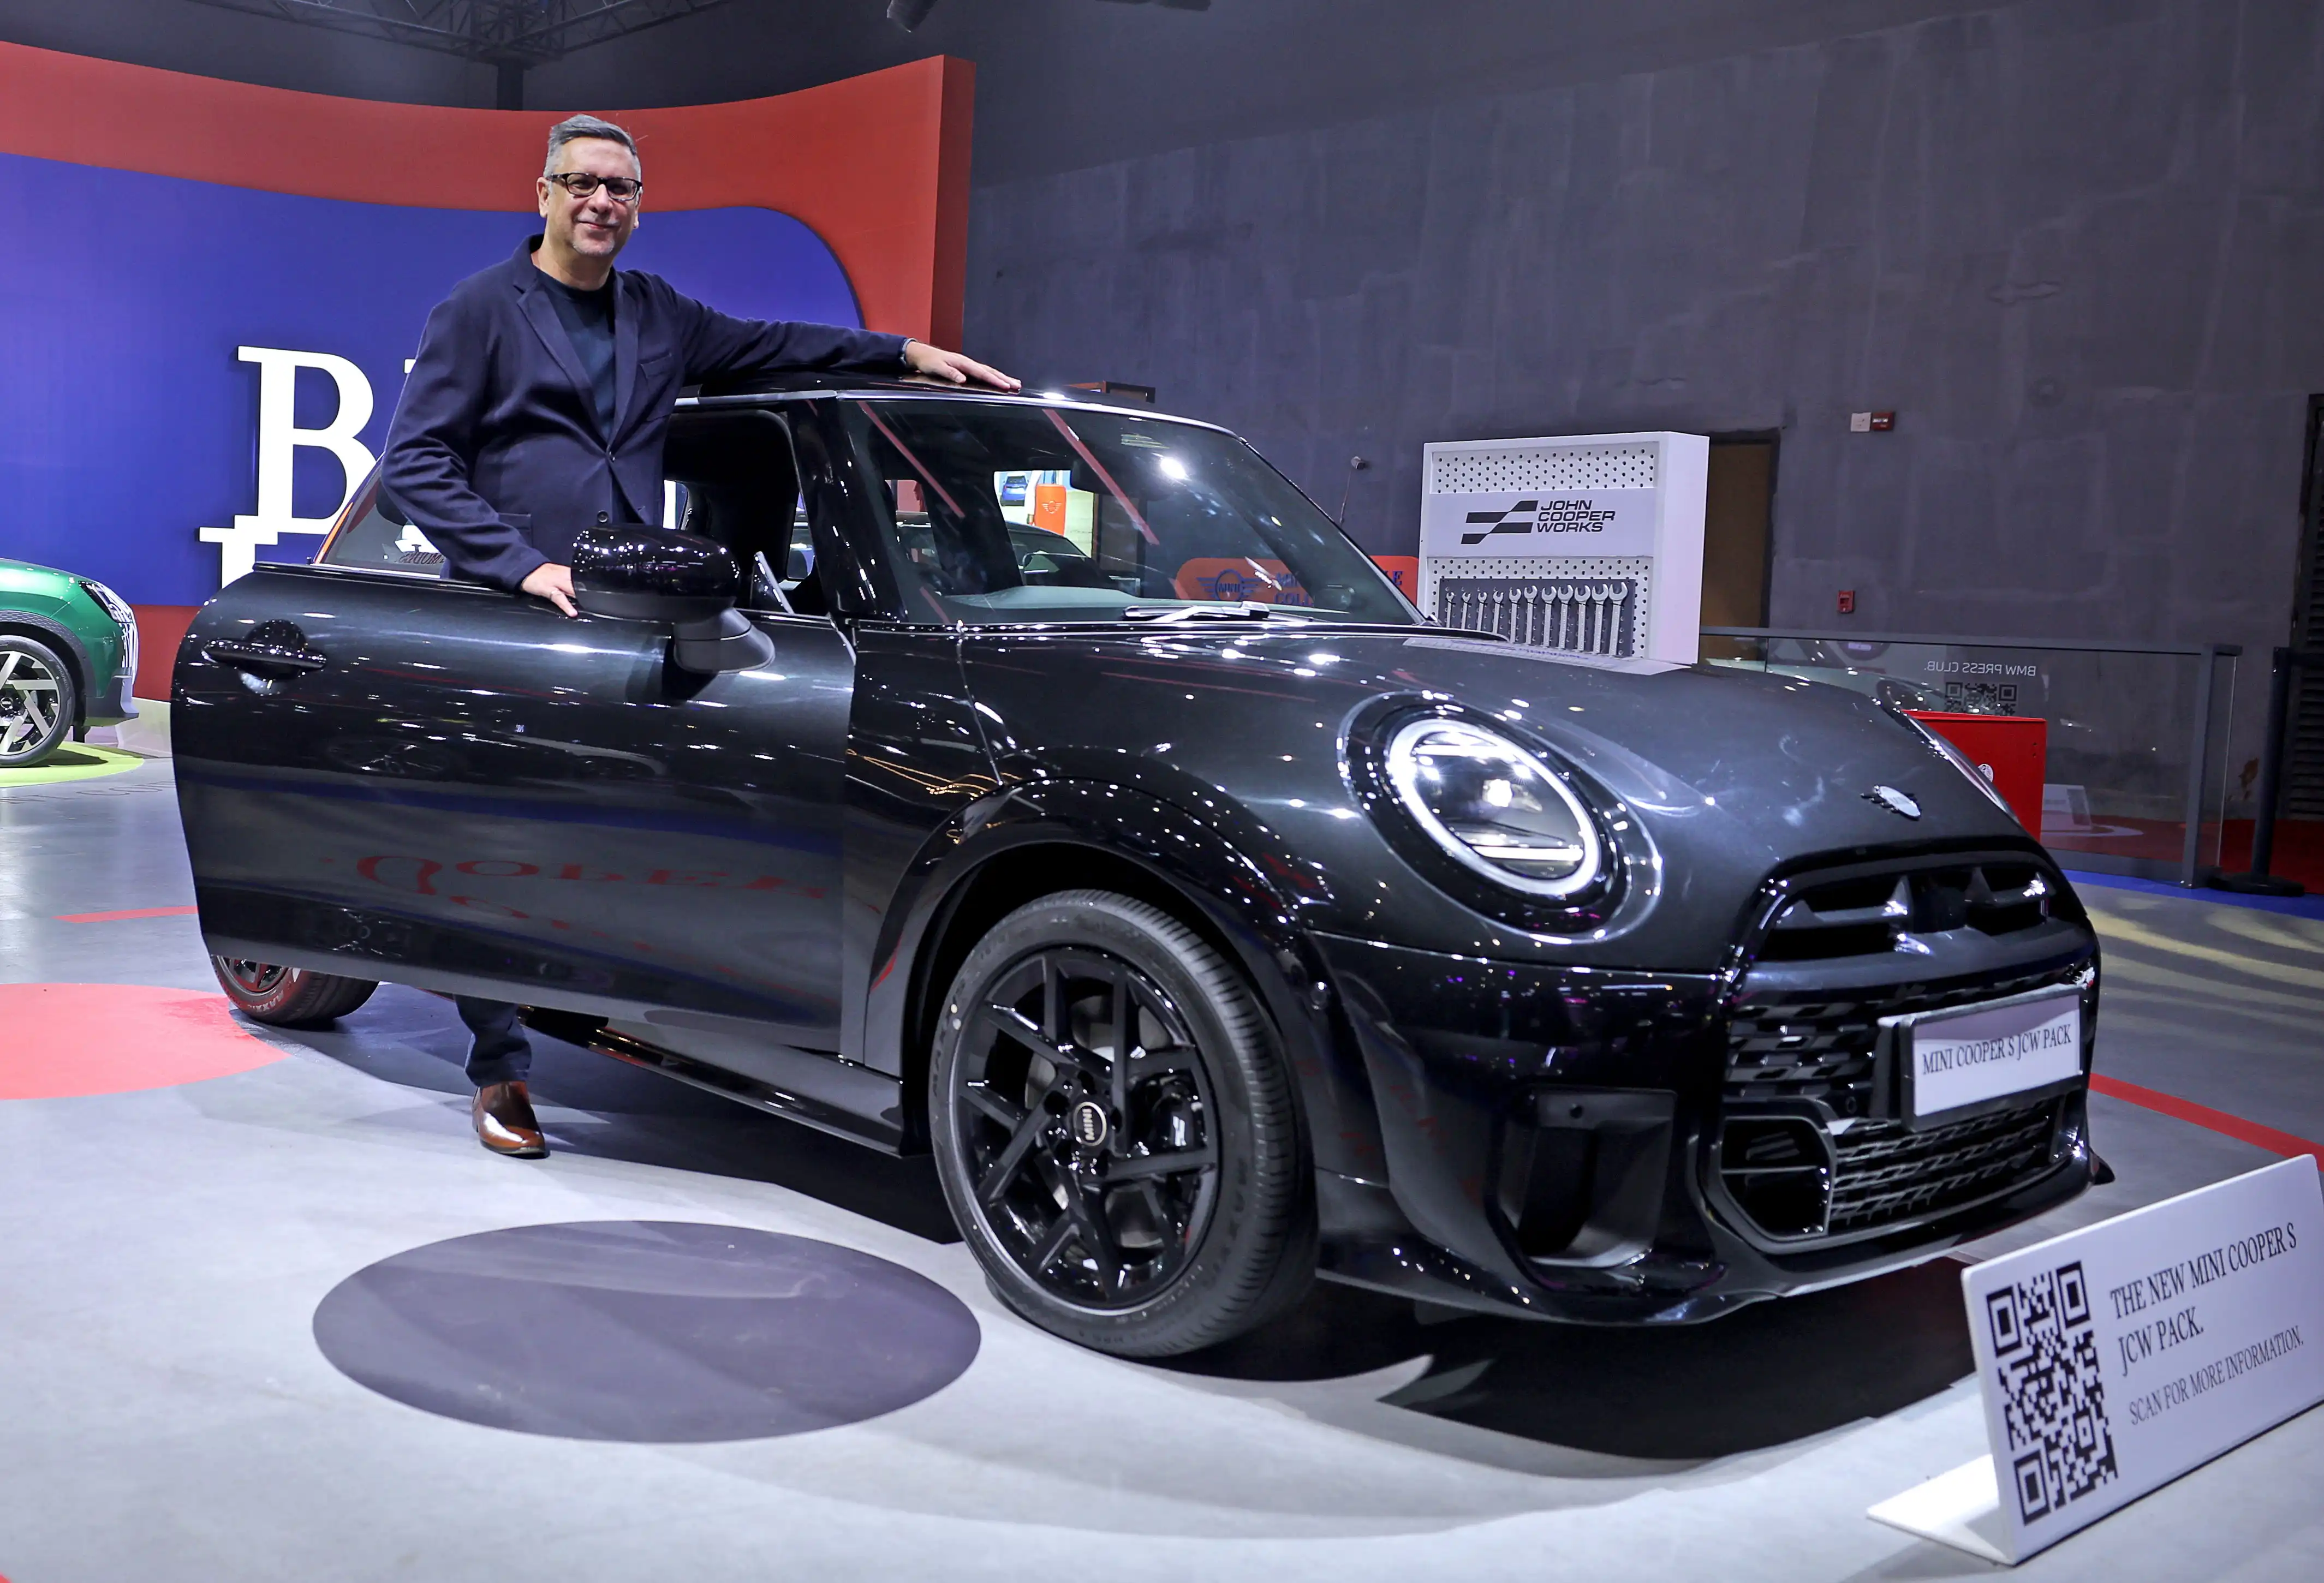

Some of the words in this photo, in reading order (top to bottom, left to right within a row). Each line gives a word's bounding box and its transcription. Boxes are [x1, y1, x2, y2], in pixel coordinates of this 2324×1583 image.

[1538, 511, 1616, 522] COOPER
[1540, 500, 1592, 511] JOHN
[1537, 522, 1604, 533] WORKS
[1922, 1048, 1953, 1075] MINI
[1957, 1038, 2005, 1067] COOPER
[2008, 1037, 2015, 1056] S
[2017, 1030, 2041, 1060] JCW
[2043, 1024, 2072, 1049] PACK
[1082, 1108, 1095, 1140] MINI
[2110, 1280, 2146, 1319] THE
[2147, 1263, 2185, 1305] NEW
[2187, 1249, 2227, 1289] MINI
[2228, 1226, 2288, 1272] COOPER
[2286, 1222, 2297, 1249] S
[2117, 1325, 2152, 1377] JCW
[2156, 1306, 2204, 1352] PACK.
[2129, 1389, 2163, 1425] SCAN
[2163, 1377, 2190, 1409] FOR
[2190, 1360, 2226, 1397] MORE
[2225, 1325, 2304, 1380] INFORMATION.
